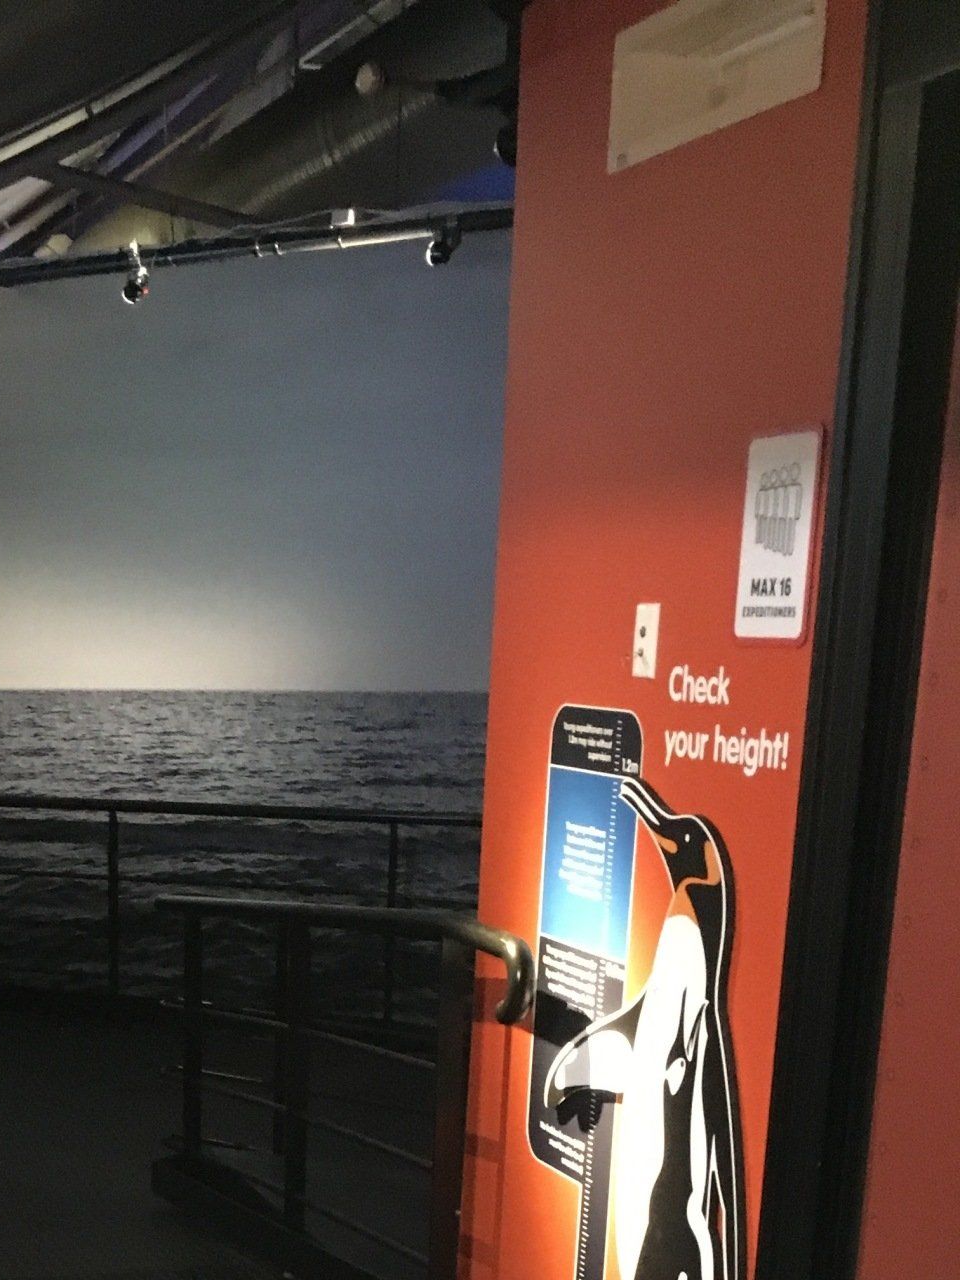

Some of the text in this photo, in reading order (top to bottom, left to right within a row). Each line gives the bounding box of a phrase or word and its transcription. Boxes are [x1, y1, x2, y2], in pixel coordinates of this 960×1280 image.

[750, 576, 792, 597] MAX 16
[742, 606, 796, 618] EXPEDITIONERS
[668, 664, 730, 705] Check
[664, 723, 789, 777] your height!
[621, 757, 639, 774] 1.2m
